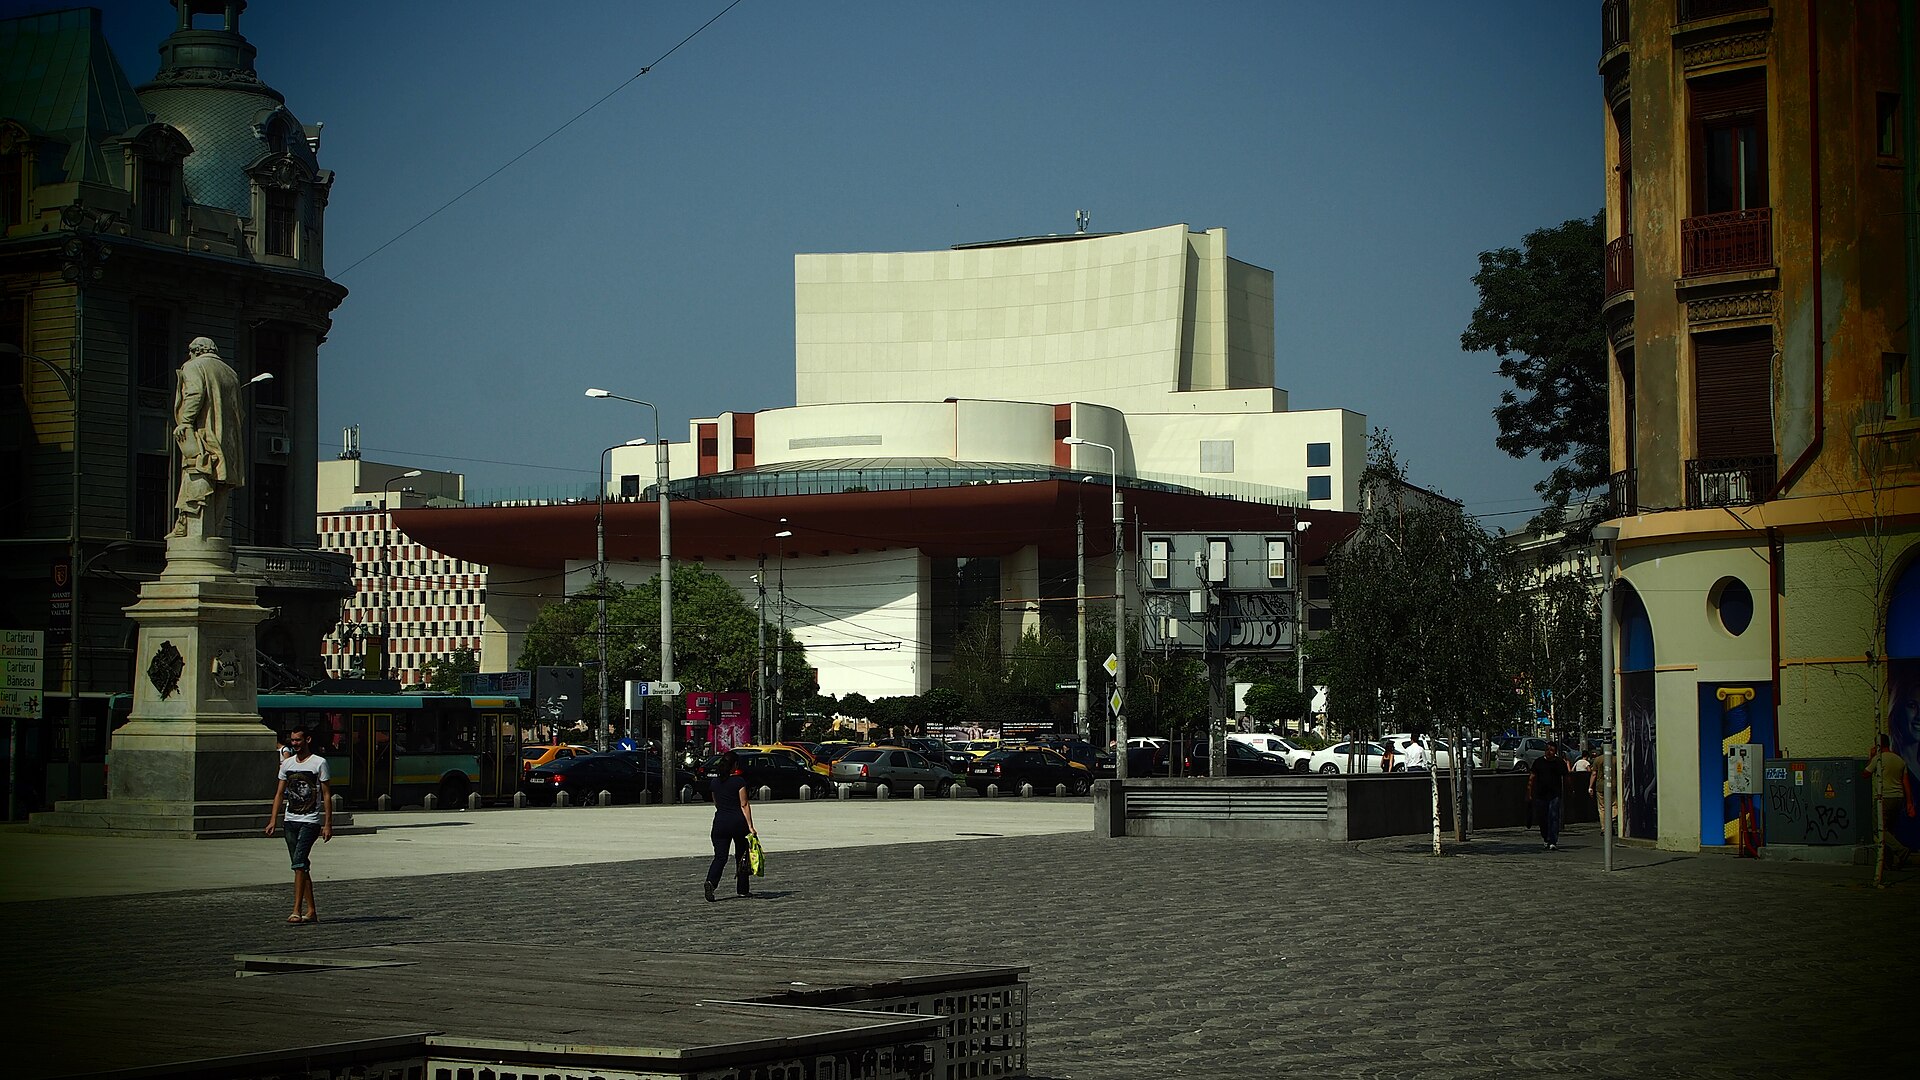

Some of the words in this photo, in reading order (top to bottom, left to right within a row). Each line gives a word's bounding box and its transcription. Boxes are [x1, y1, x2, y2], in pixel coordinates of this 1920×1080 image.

[5, 631, 35, 643] Cartierul
[1, 644, 38, 657] Pantelimon
[6, 661, 36, 673] Cartierul
[0, 690, 18, 702] tierul
